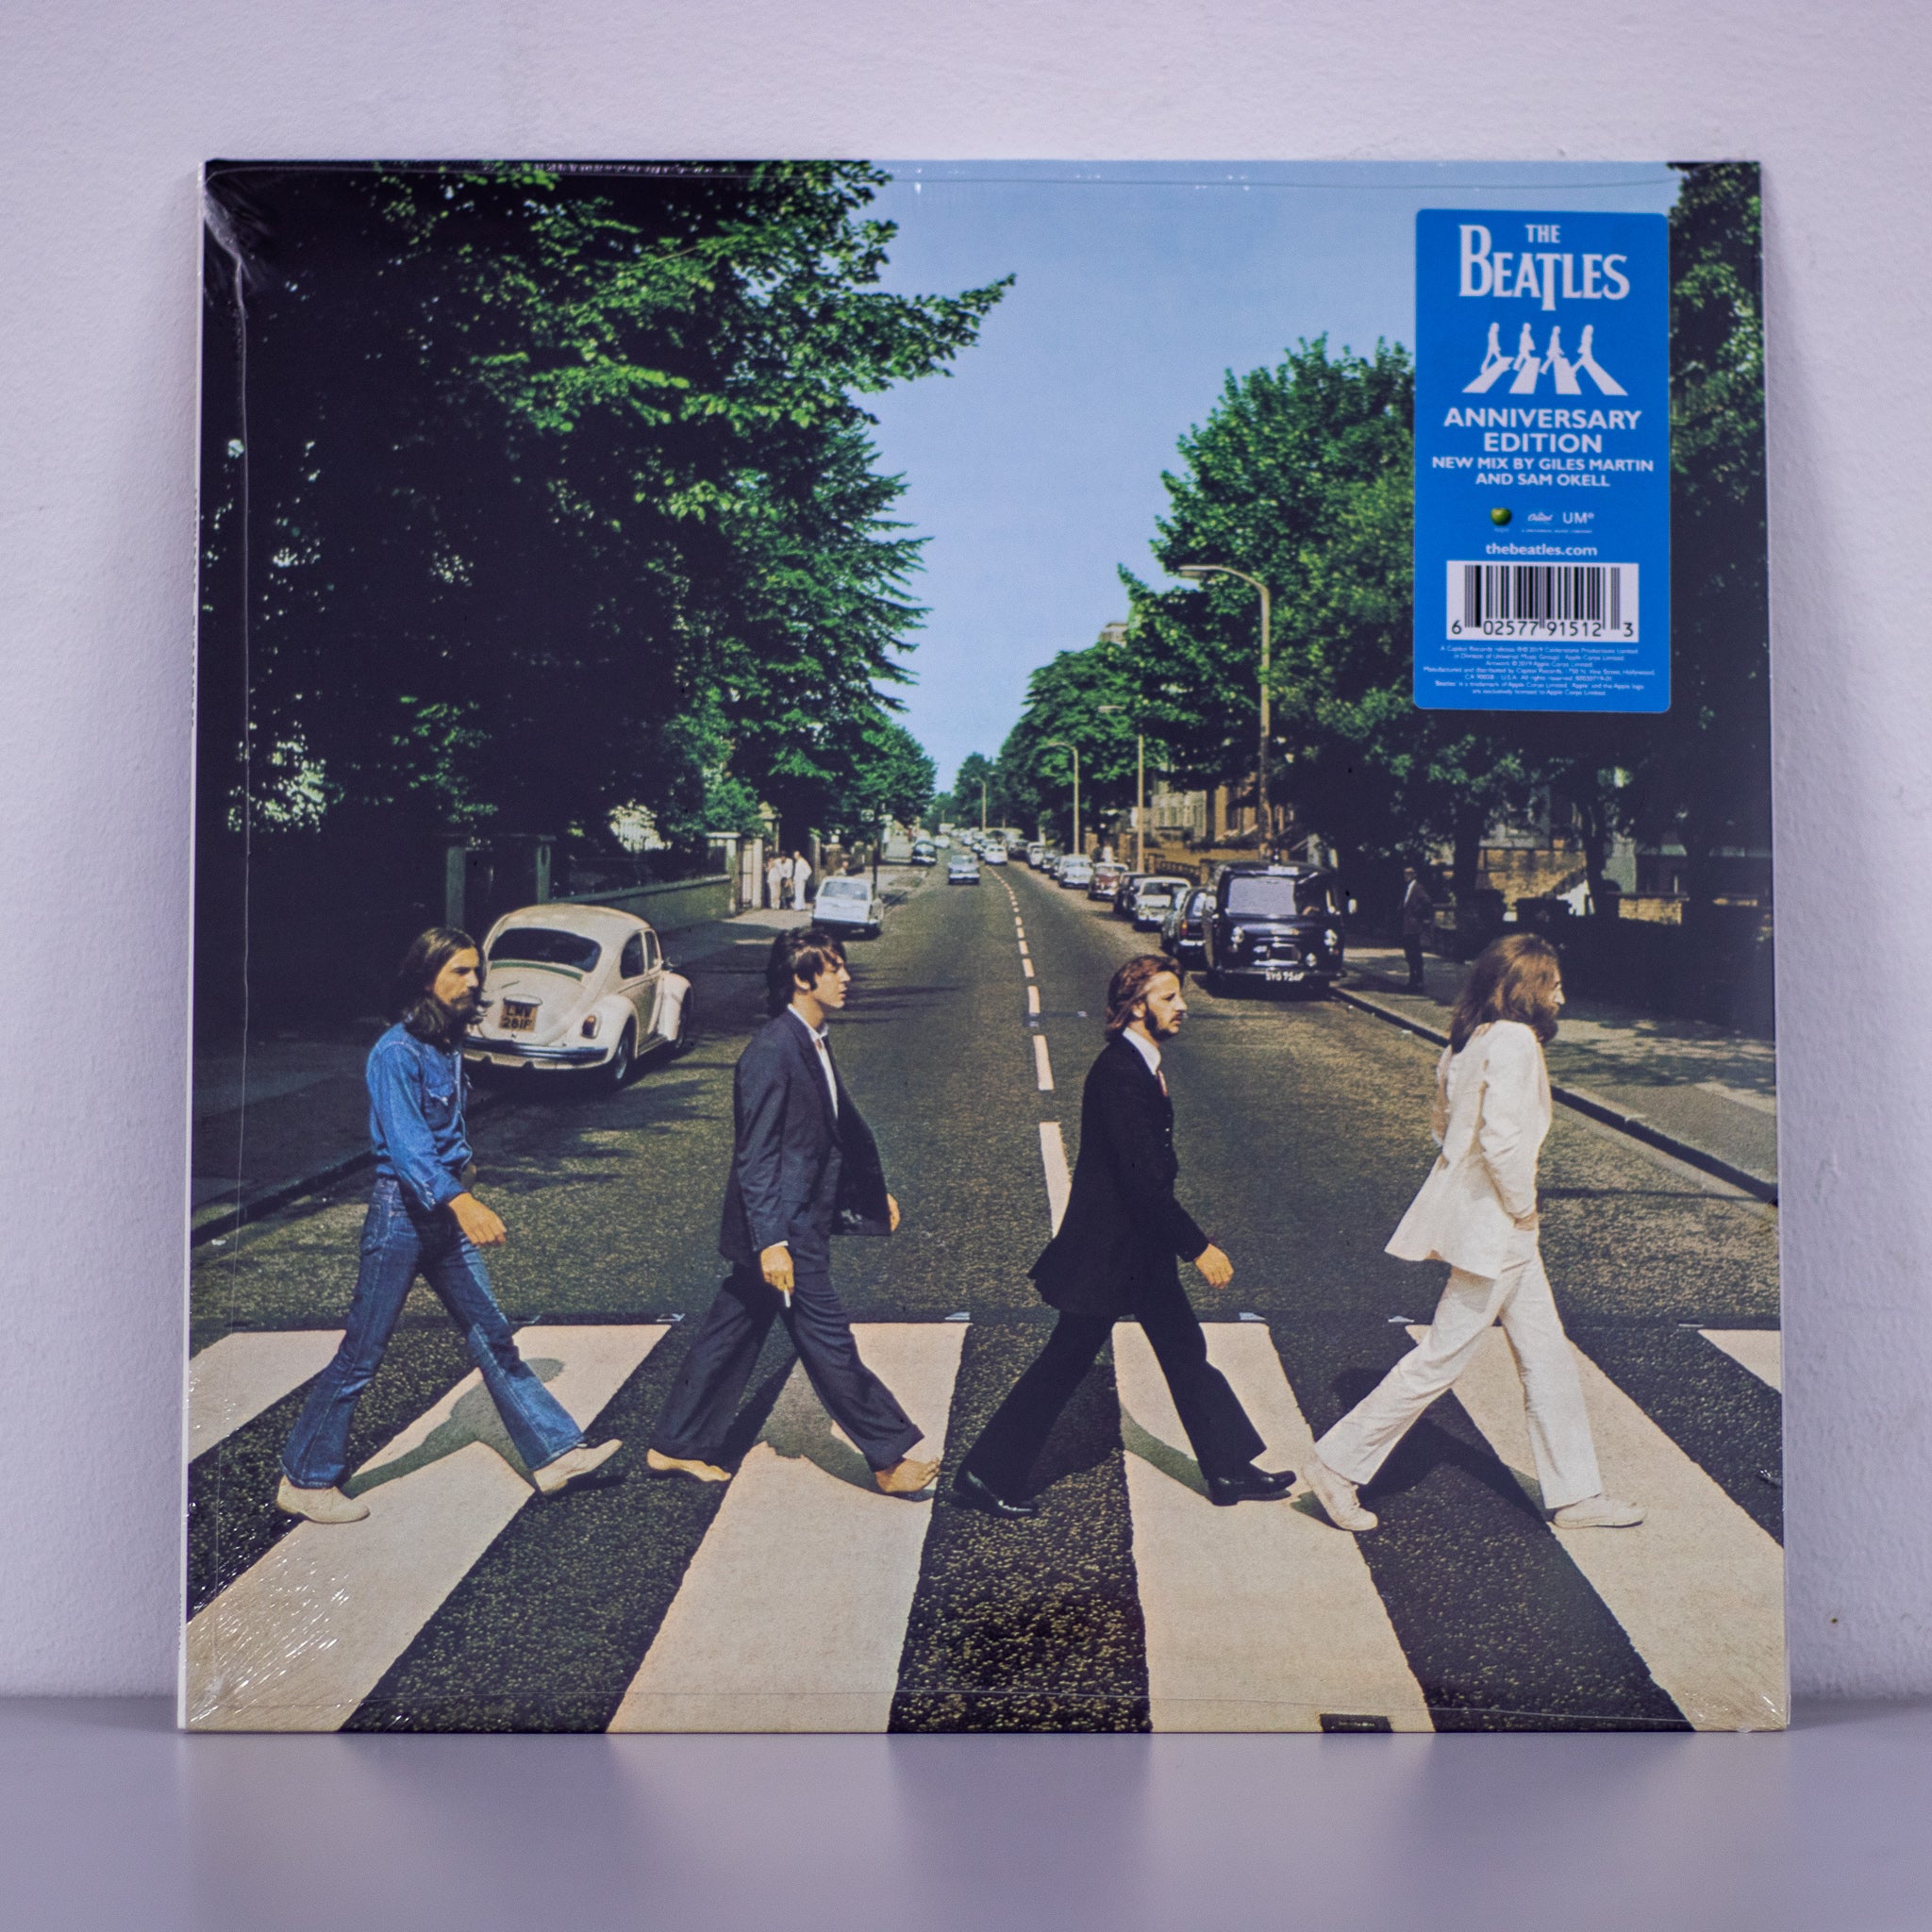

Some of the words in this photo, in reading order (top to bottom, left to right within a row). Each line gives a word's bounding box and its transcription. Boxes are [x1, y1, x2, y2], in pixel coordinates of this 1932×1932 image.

[1524, 224, 1560, 243] THE
[1458, 224, 1630, 311] BEATLES
[1443, 407, 1642, 430] ANNIVERSARY
[1484, 431, 1603, 454] EDITION
[1432, 456, 1474, 469] NEW
[1477, 457, 1508, 470] MIX
[1512, 457, 1535, 471] BY
[1538, 458, 1586, 471] GILES
[1589, 458, 1654, 472] MARTIN
[1475, 473, 1514, 486] AND
[1517, 473, 1553, 486] SAM
[1557, 473, 1610, 487] OKELL
[1485, 542, 1598, 557] thebeatles.com
[1451, 620, 1462, 635] 6
[1483, 621, 1540, 636] 02577
[1546, 622, 1602, 638] 91512
[1624, 622, 1634, 638] 3
